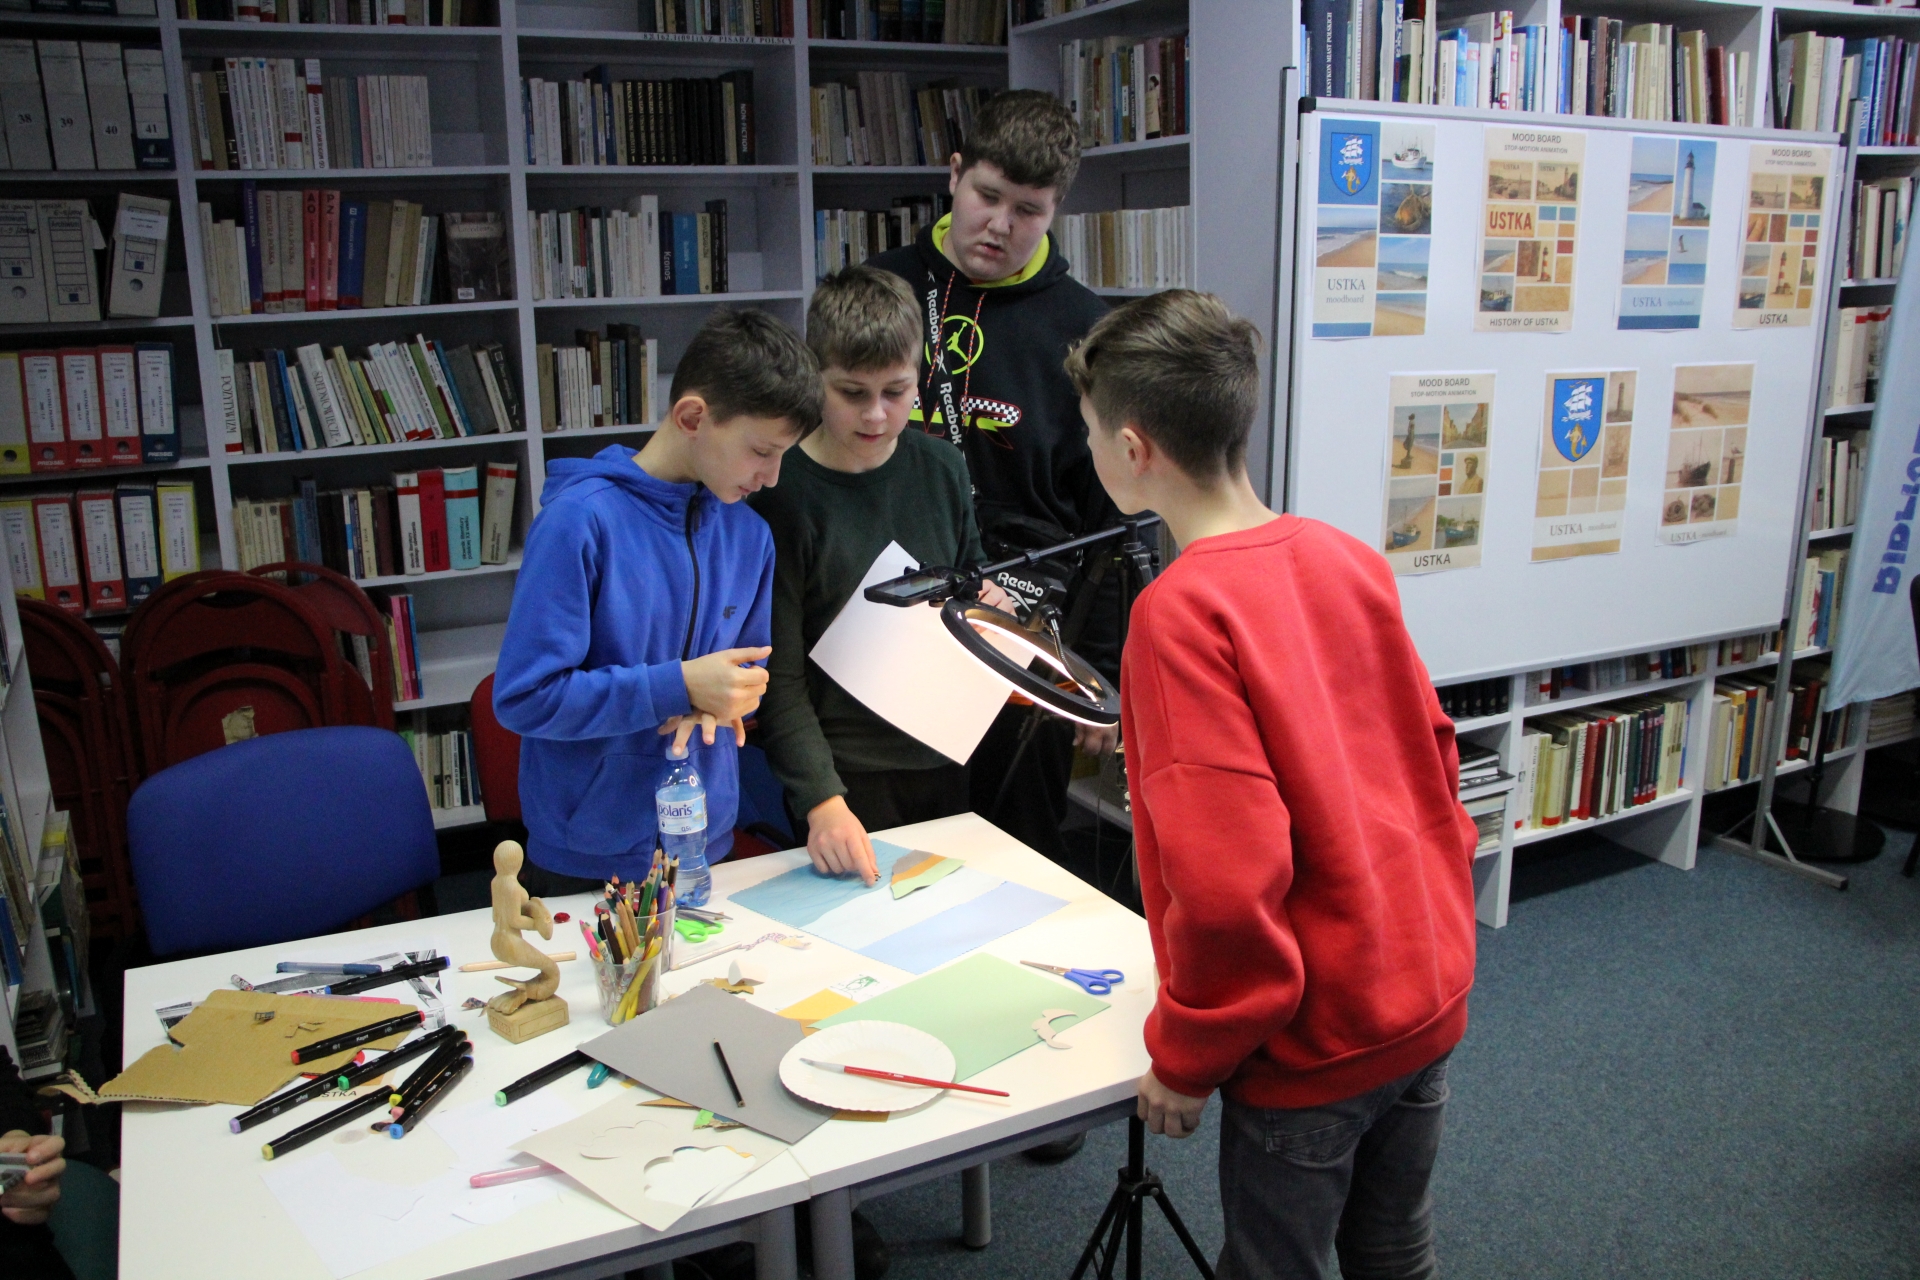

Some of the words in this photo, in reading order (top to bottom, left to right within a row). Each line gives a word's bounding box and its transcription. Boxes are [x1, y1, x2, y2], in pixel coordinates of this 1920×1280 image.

[719, 36, 756, 44] PISARZE
[1860, 96, 1870, 130] POLSKI
[18, 114, 32, 124] 38
[60, 118, 74, 128] 39
[105, 126, 118, 135] 40
[146, 124, 157, 134] 41
[1512, 133, 1535, 142] MOOD
[1537, 134, 1562, 144] BOARD
[1504, 144, 1539, 152] STOP-MOTION
[1772, 148, 1790, 157] MOOD
[1792, 150, 1812, 158] BOARD
[307, 192, 315, 202] A
[326, 194, 334, 202] P
[326, 206, 334, 214] Z
[1489, 210, 1532, 231] USTKA
[664, 251, 672, 280] Kronos
[1327, 278, 1366, 290] USTKA
[1326, 294, 1364, 304] moodboard
[1632, 296, 1662, 308] USTKA
[926, 288, 940, 344] Reebok
[1759, 313, 1788, 324] USTKA
[1489, 318, 1522, 327] HISTORY
[1523, 318, 1534, 326] OF
[1535, 316, 1560, 326] USTKA
[1418, 378, 1442, 387] MOOD
[1444, 377, 1470, 387] BOARD
[1410, 390, 1447, 398] STOP-MOTION
[1448, 389, 1477, 397] ANIMATION
[221, 375, 238, 434] POZYTYWIZM
[940, 382, 962, 445] Reebok
[1550, 523, 1583, 536] USTKA
[1670, 532, 1696, 542] USTKA
[1413, 554, 1451, 568] USTKA
[997, 571, 1044, 598] Reebo
[658, 804, 692, 817] polaris
[320, 1090, 357, 1098] STKA
